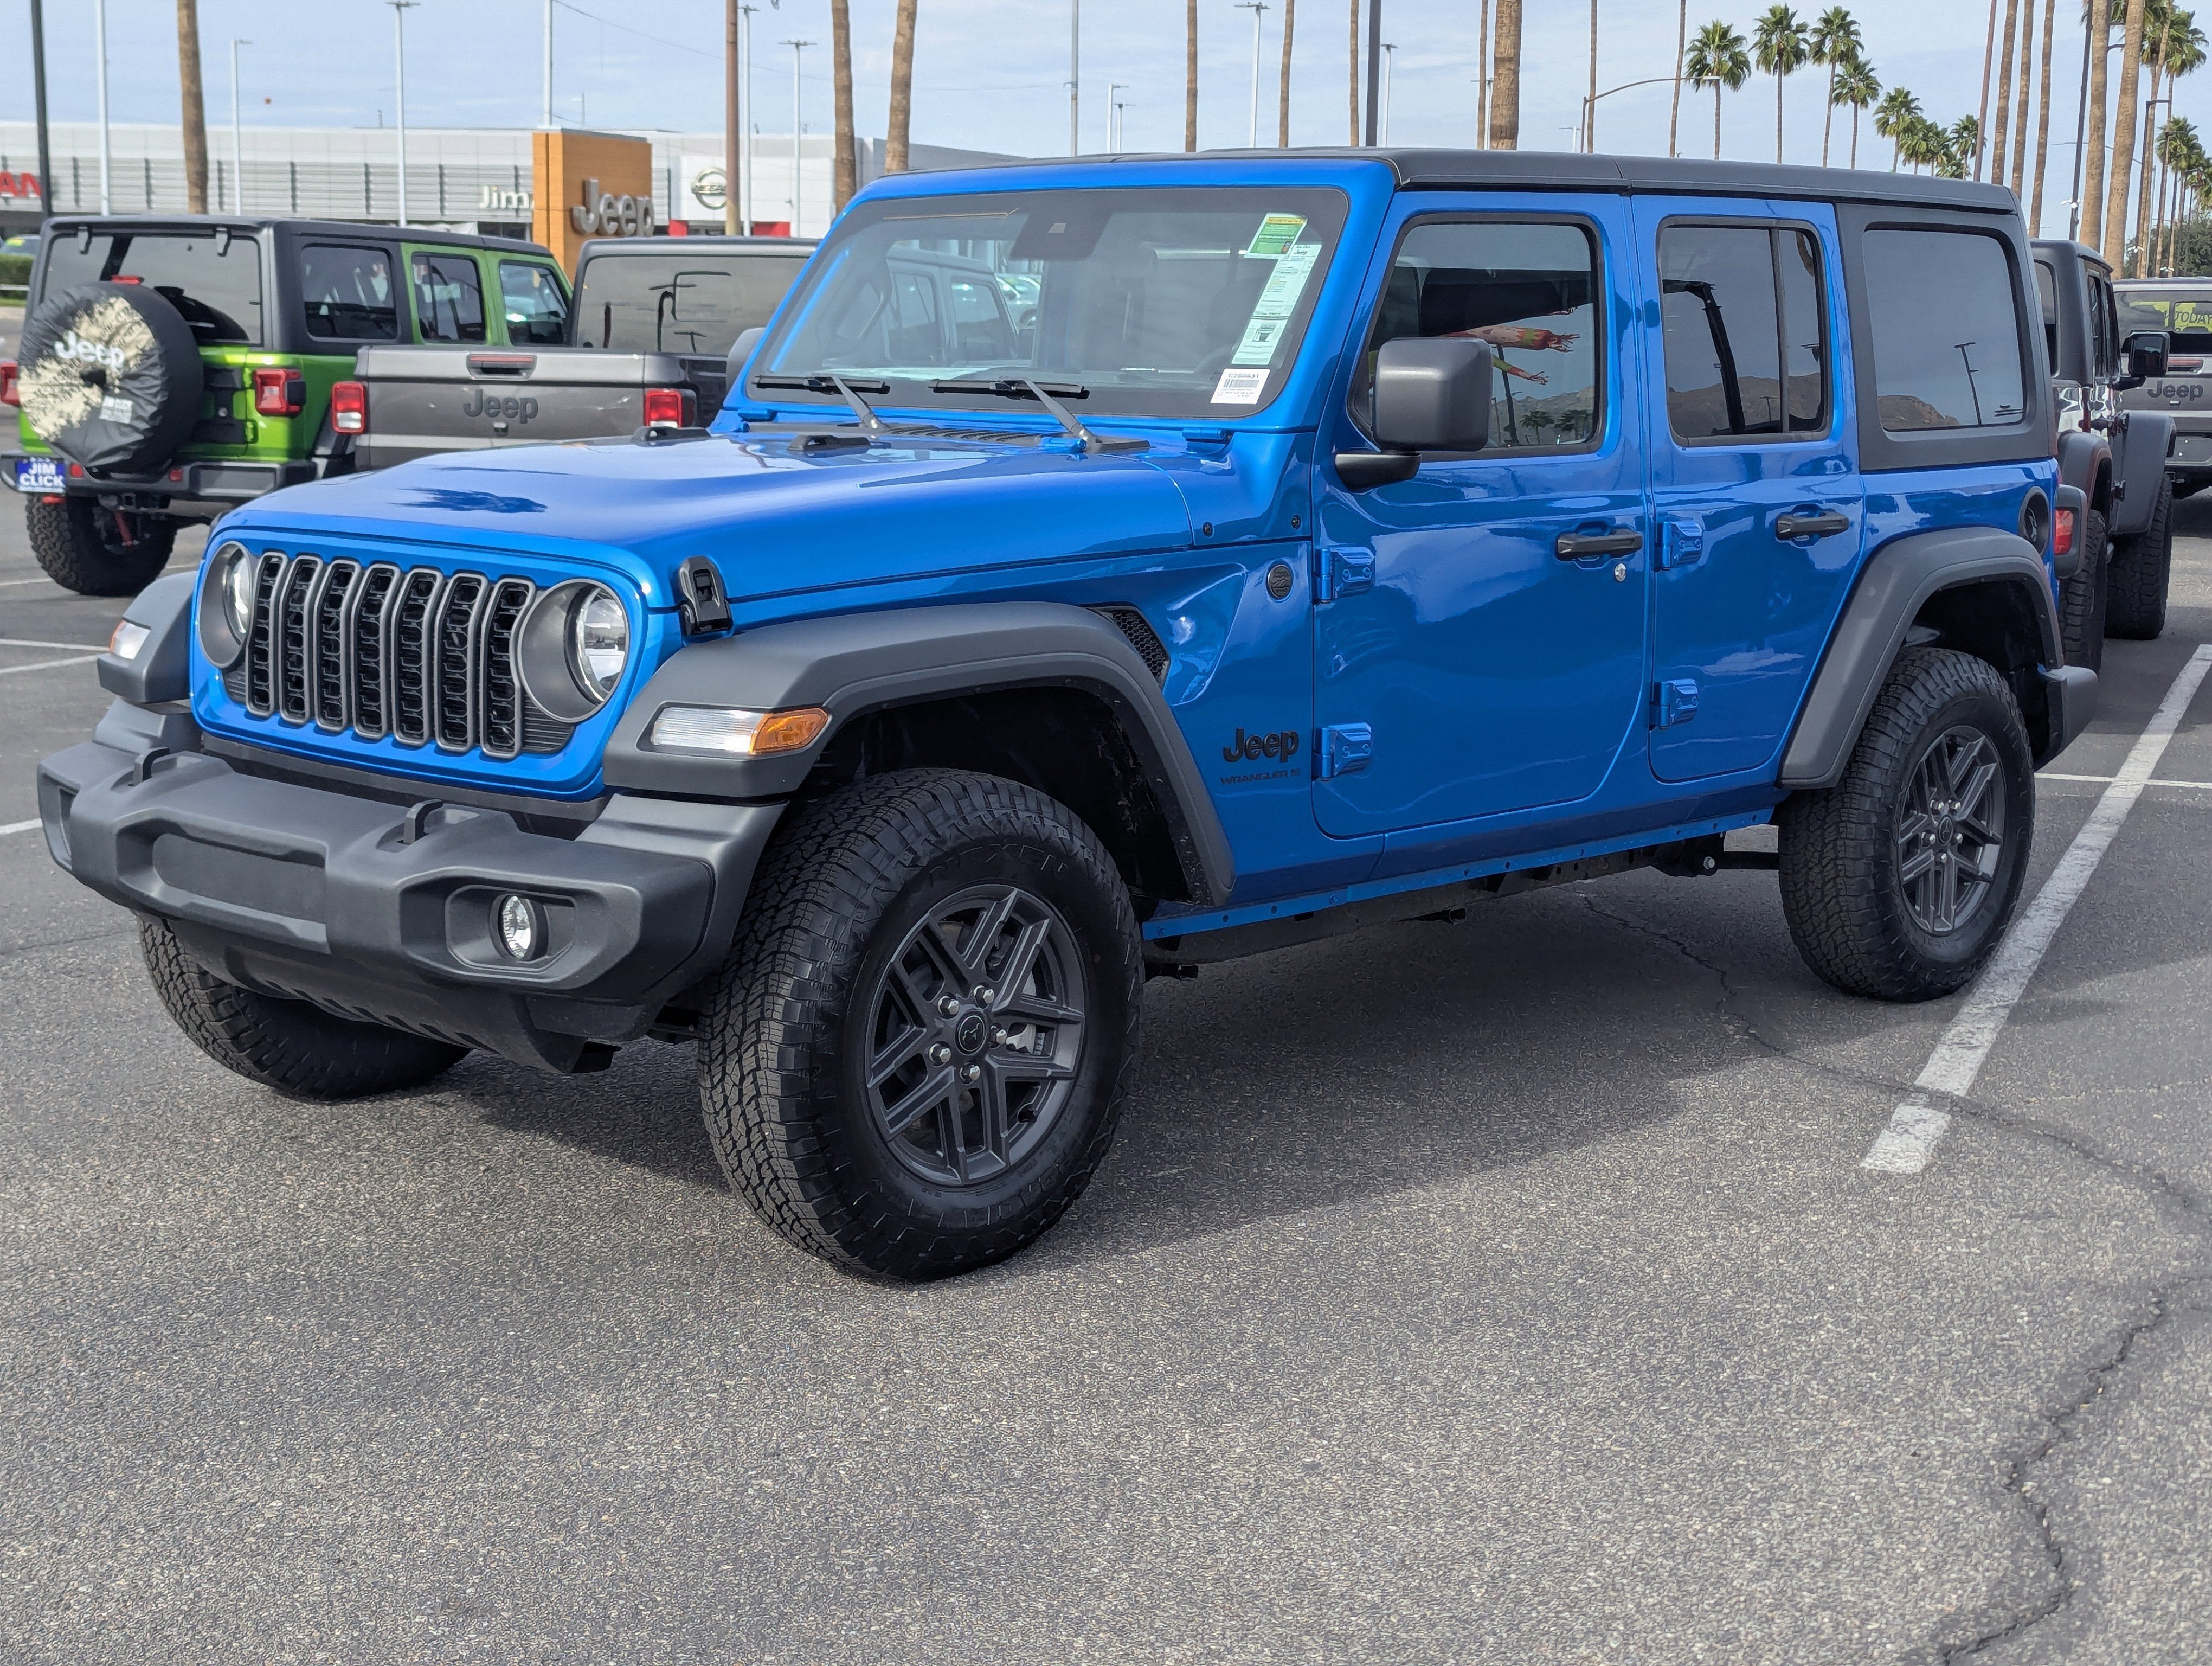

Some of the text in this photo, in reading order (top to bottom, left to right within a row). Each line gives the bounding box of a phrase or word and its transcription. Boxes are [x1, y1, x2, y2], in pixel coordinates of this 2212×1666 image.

[479, 185, 529, 209] Jim
[571, 178, 654, 236] Jeep
[54, 331, 125, 373] Jeep
[2147, 380, 2203, 401] Jeep
[463, 389, 539, 425] Jeep
[19, 472, 66, 487] CLICK
[28, 462, 56, 475] JIM
[1223, 727, 1300, 764] Jeep
[1220, 769, 1288, 785] WRANGLER
